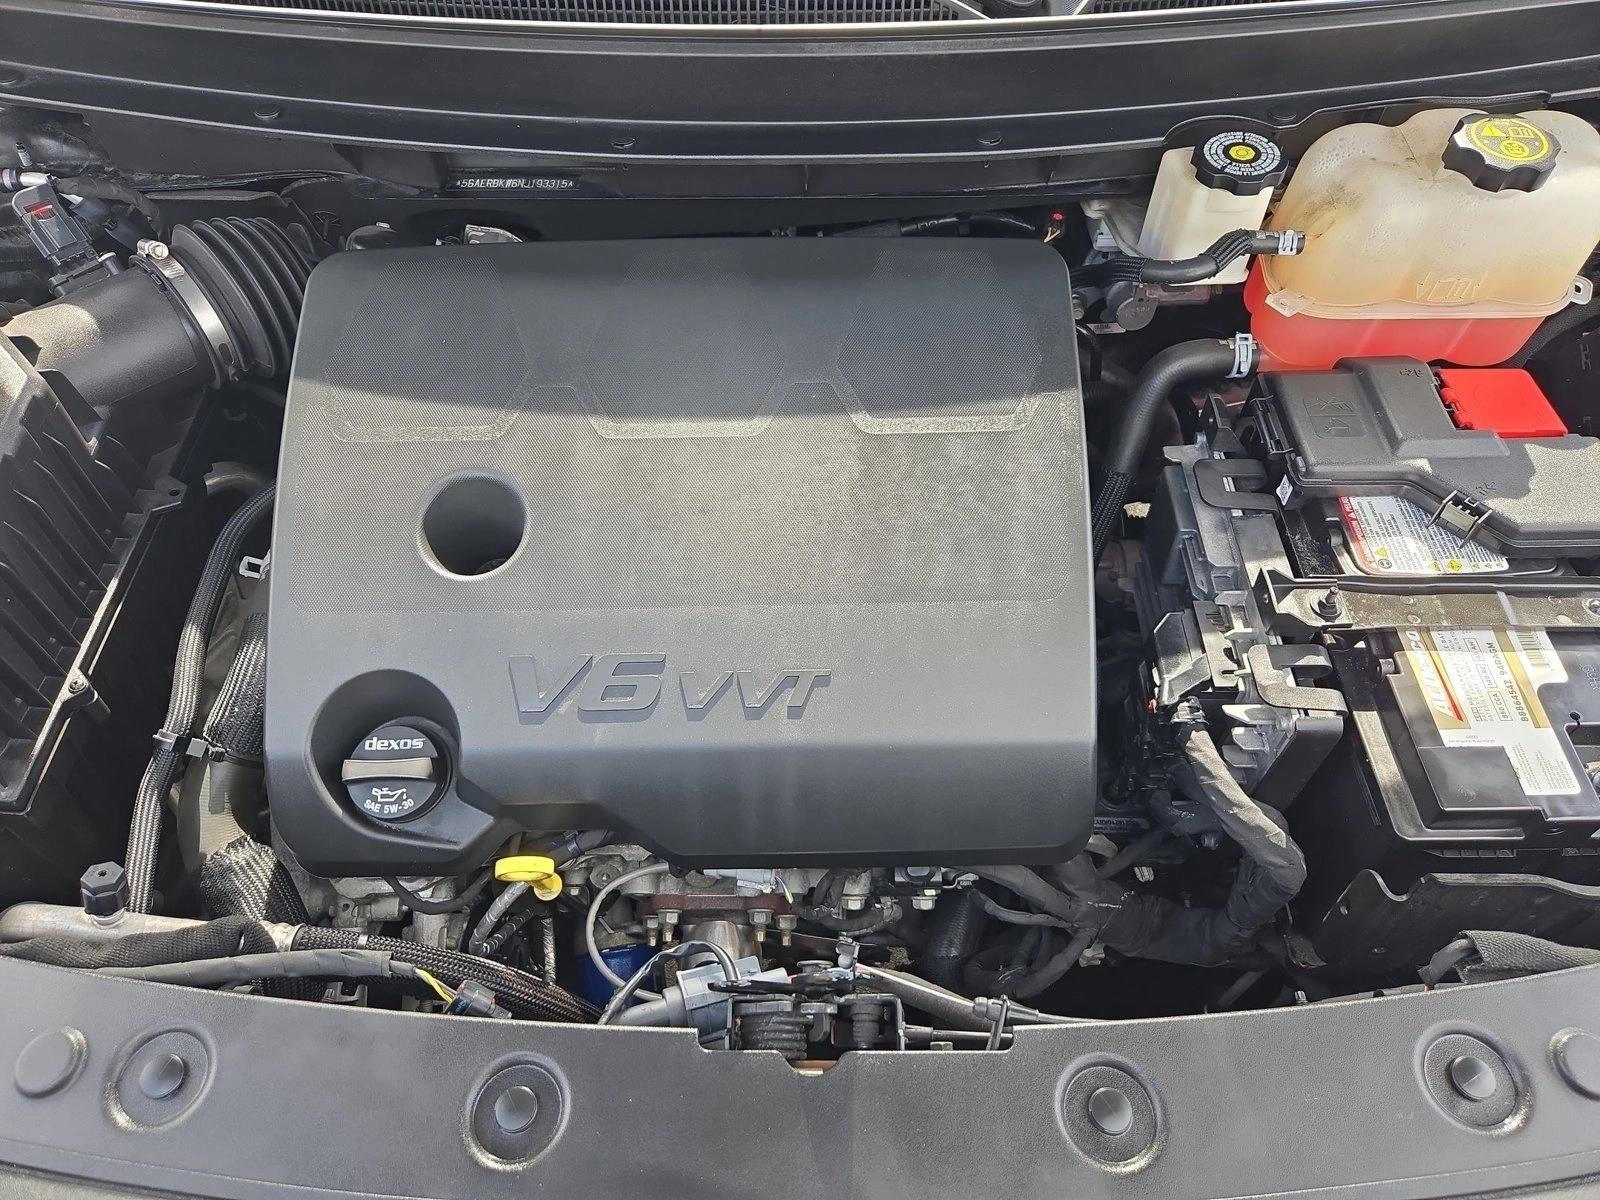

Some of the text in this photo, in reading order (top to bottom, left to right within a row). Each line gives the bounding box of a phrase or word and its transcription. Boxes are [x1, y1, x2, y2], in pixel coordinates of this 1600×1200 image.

[1486, 642, 1508, 676] 94RAGM
[508, 652, 831, 725] V6 VVT
[364, 736, 424, 750] dexos
[364, 798, 414, 813] SAE 5W-30
